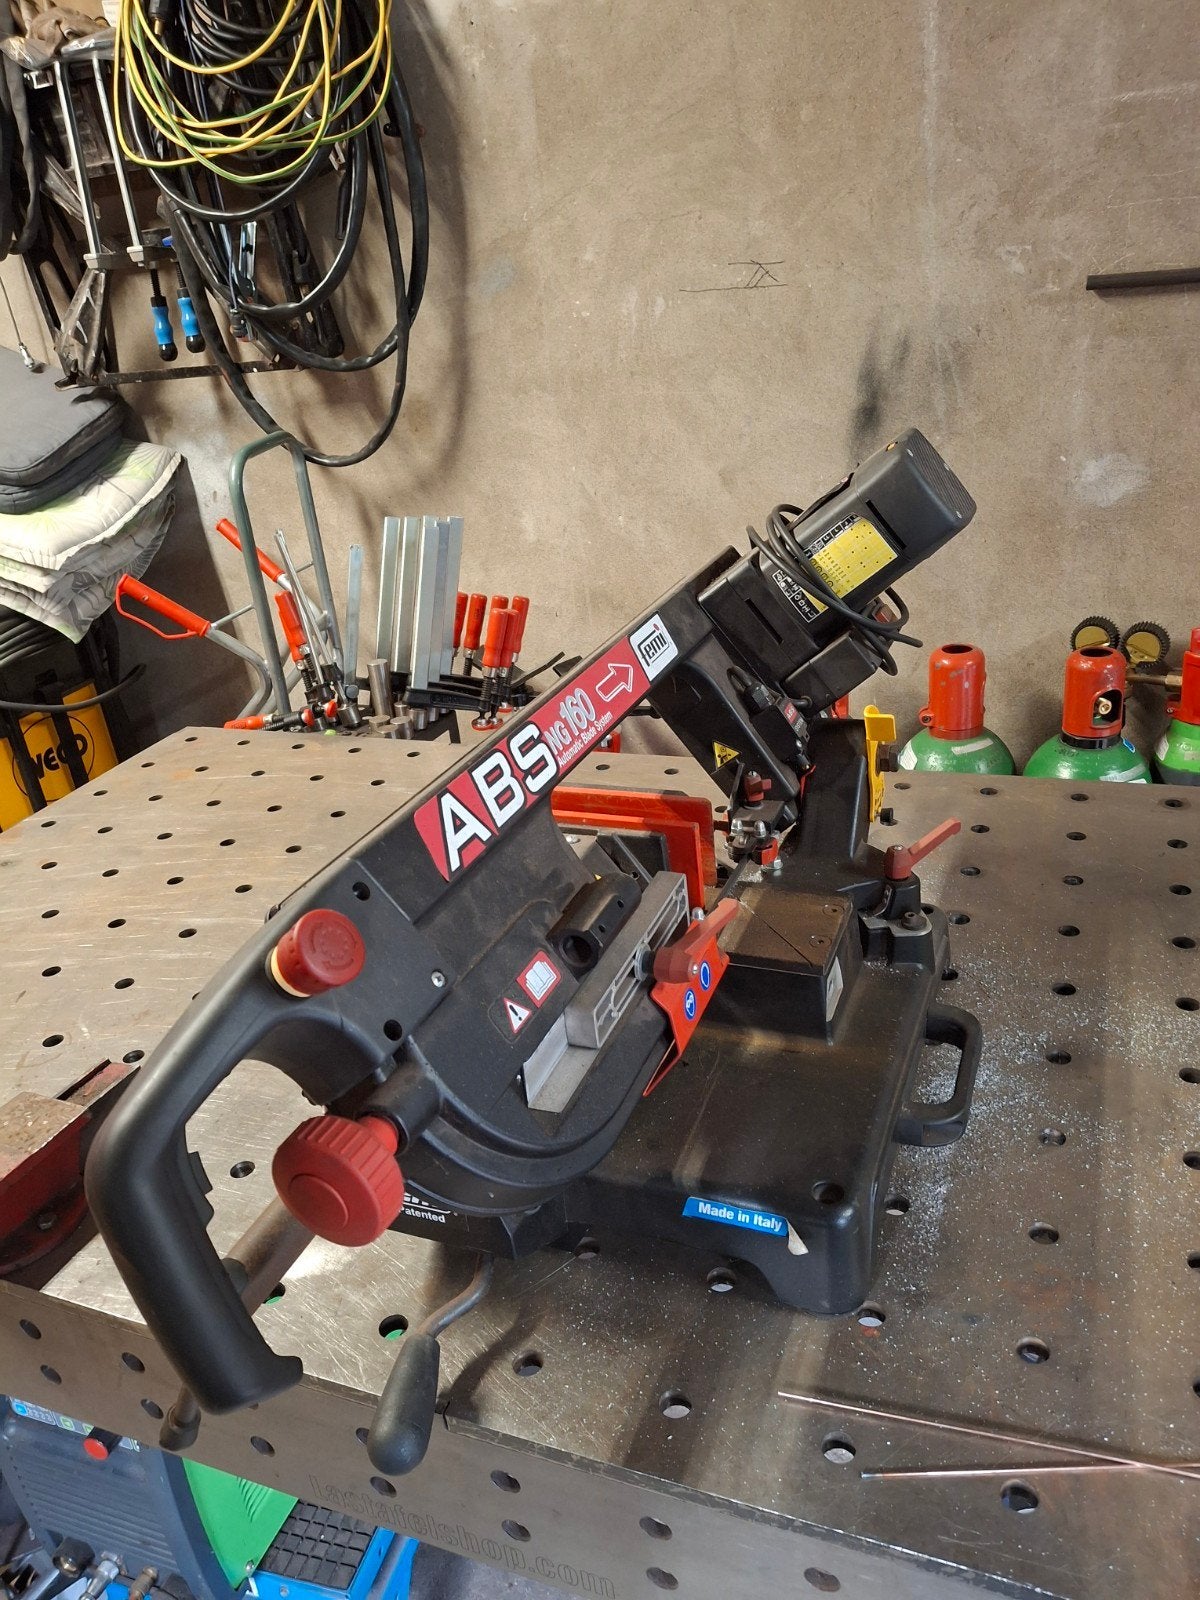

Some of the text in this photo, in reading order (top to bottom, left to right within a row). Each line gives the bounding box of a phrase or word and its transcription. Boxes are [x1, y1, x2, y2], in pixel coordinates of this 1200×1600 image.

[557, 711, 613, 768] Automatic Blade System
[440, 722, 558, 873] ABS
[544, 721, 572, 755] NG
[559, 688, 596, 736] 160
[698, 1201, 782, 1232] Made in Italy
